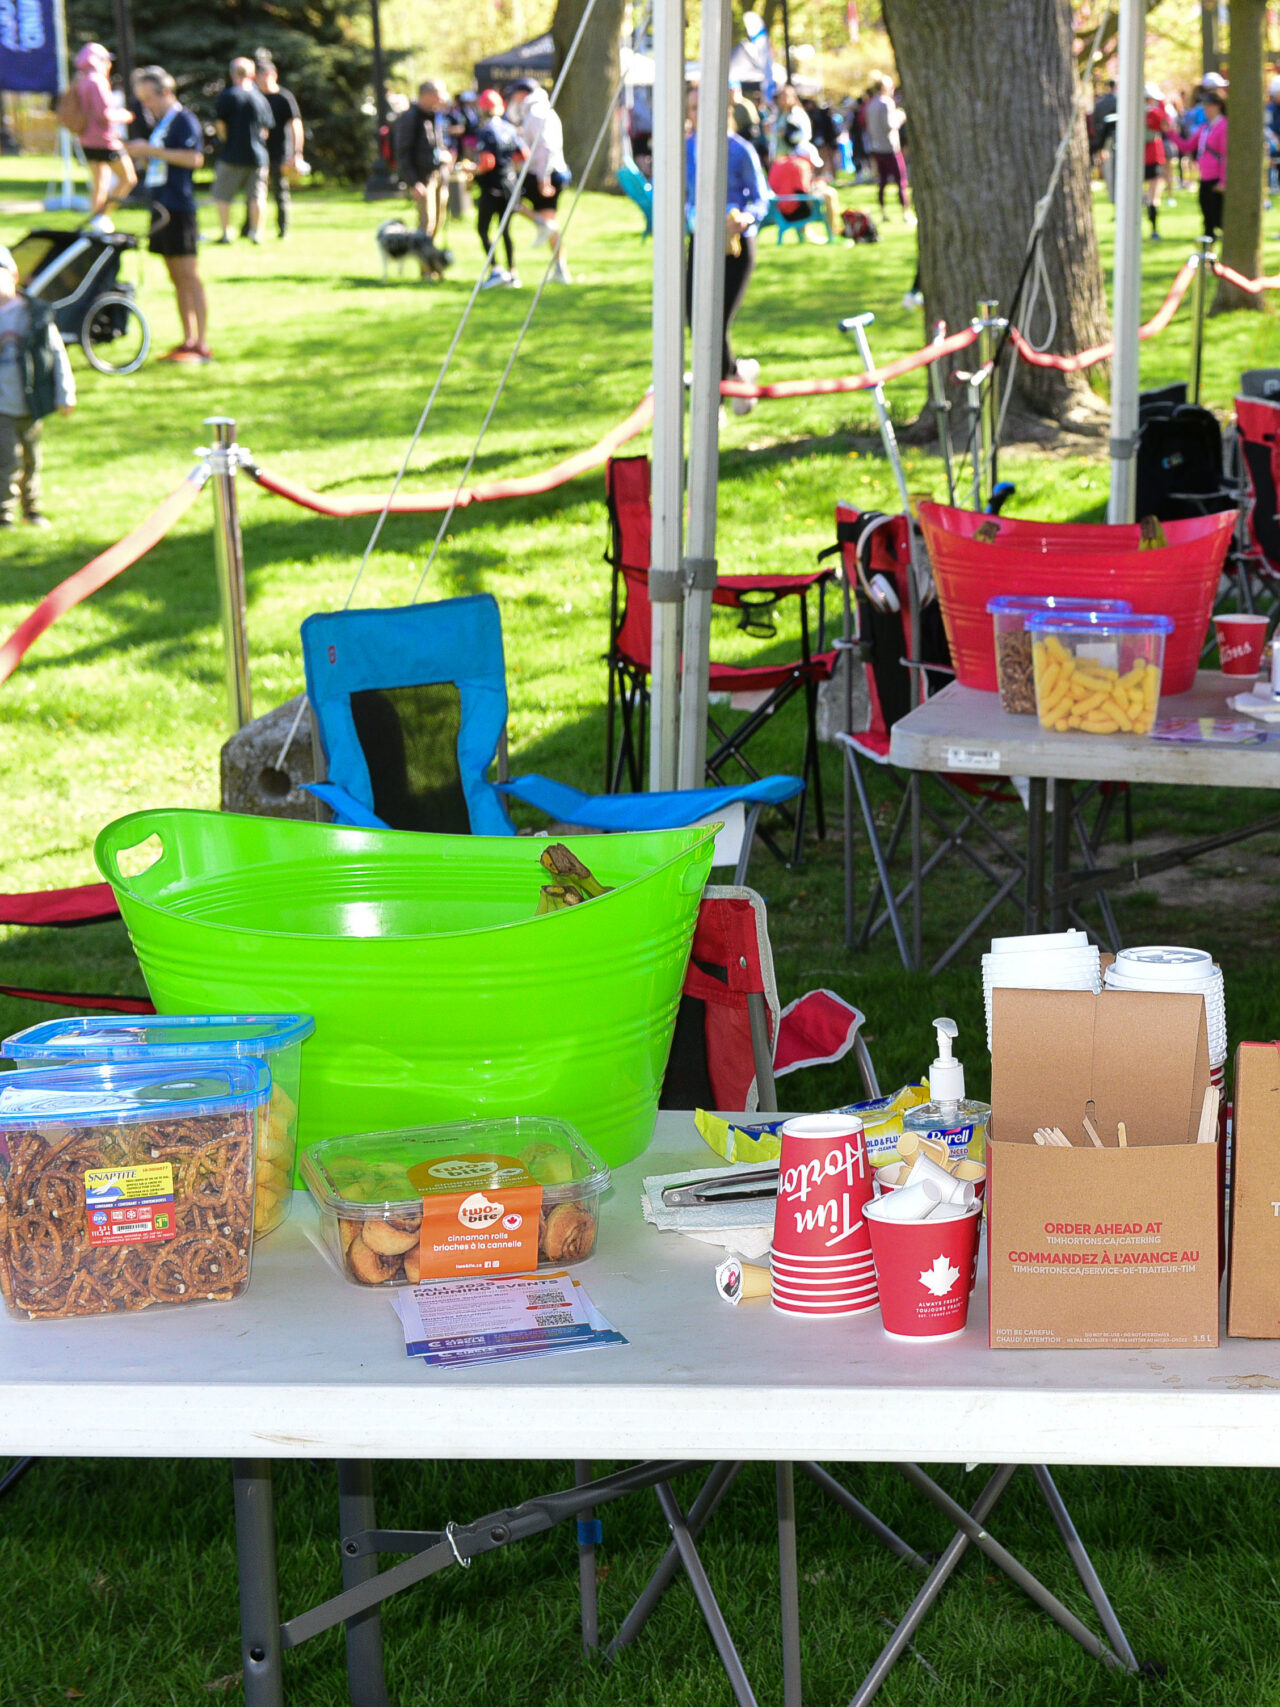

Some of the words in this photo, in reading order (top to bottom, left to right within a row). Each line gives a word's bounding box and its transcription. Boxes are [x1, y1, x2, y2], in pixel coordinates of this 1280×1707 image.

[931, 1128, 970, 1145] Purell
[461, 1205, 498, 1216] two-
[468, 1213, 498, 1223] bite
[793, 1193, 863, 1247] Tim
[1044, 1222, 1092, 1235] ORDER
[1094, 1223, 1143, 1235] AHEAD
[1145, 1222, 1163, 1233] AT
[447, 1233, 490, 1242] cinnamon
[490, 1232, 508, 1240] rolls
[1046, 1235, 1161, 1246] TIMHORTONS.CA/CATERING
[433, 1243, 468, 1251] brioches
[470, 1242, 476, 1250] à
[487, 1240, 522, 1249] cannelle
[1008, 1250, 1098, 1265] COMMANDEZ
[1101, 1250, 1111, 1265] À
[1114, 1251, 1178, 1265] L'AVANCE
[1181, 1250, 1200, 1262] AU
[1012, 1264, 1196, 1276] TIMHORTONS.CA/SERVICE-DE-TRAITEUR-TIM
[413, 1286, 451, 1294] FALL
[414, 1287, 492, 1298] RUNNING
[496, 1280, 558, 1289] EVENTS
